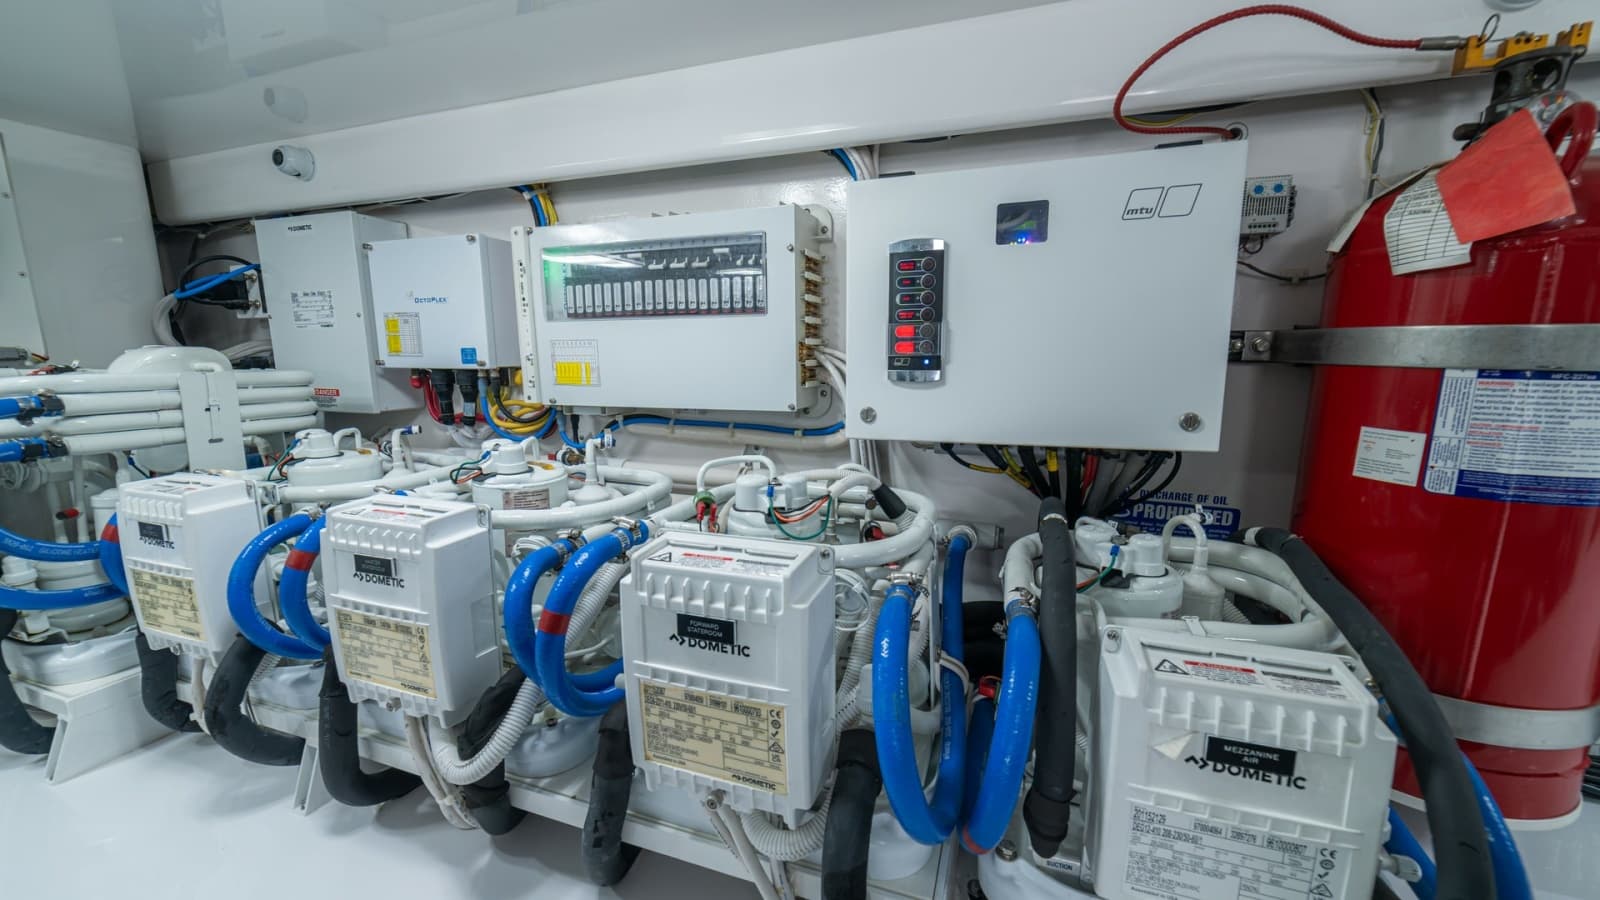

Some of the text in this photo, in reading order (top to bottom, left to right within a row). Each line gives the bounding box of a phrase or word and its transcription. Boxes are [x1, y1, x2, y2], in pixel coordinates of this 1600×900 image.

[1126, 206, 1154, 216] mtu
[1197, 494, 1208, 504] OF
[1213, 495, 1229, 505] OIL
[365, 573, 405, 589] DOMETIC
[688, 637, 750, 657] DOMETIC
[1224, 745, 1280, 761] MEZZANINE
[1242, 756, 1260, 765] AIR
[1212, 761, 1307, 790] DOMETIC
[742, 776, 776, 791] DOMETIC
[1047, 860, 1072, 870] SUCTION
